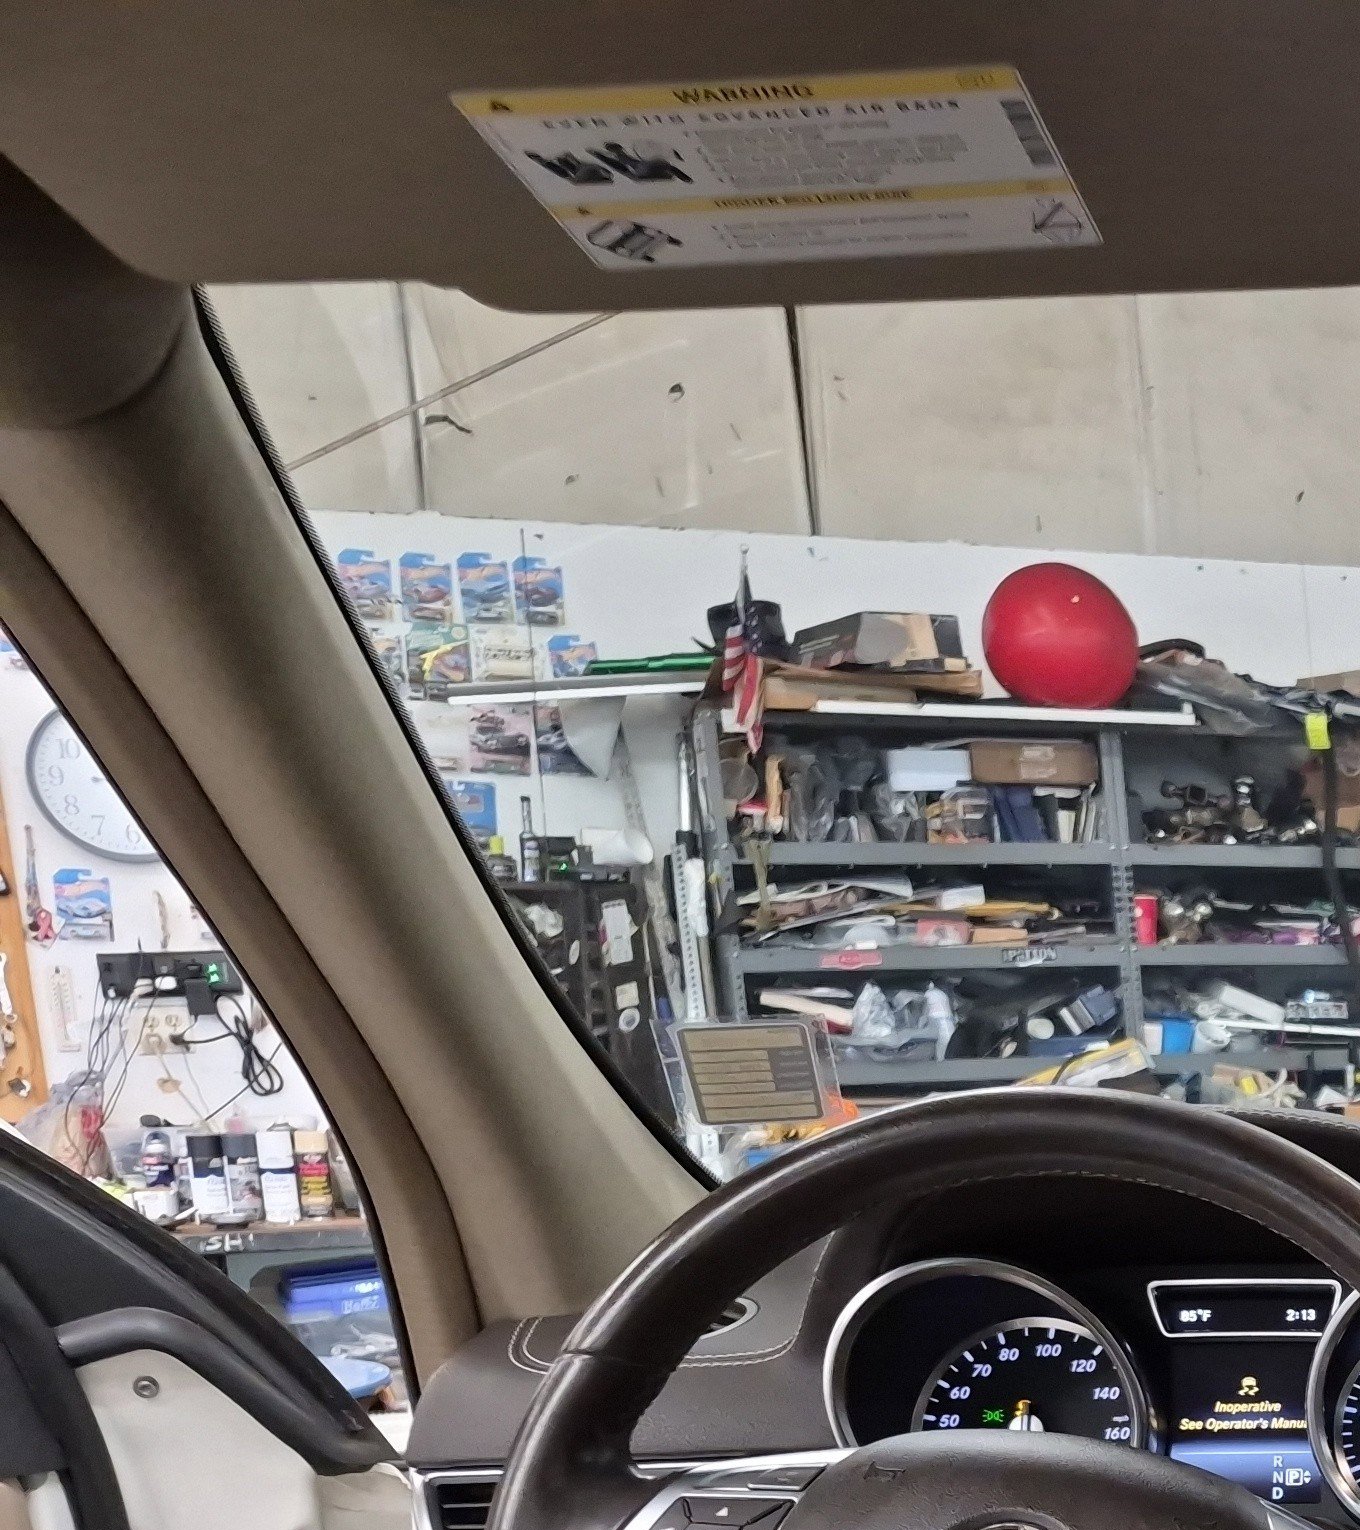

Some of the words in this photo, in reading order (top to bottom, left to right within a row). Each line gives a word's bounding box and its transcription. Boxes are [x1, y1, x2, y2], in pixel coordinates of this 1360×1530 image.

[56, 738, 81, 760] 10
[48, 765, 65, 786] 9
[65, 794, 80, 815] 8
[91, 815, 106, 836] 7
[1286, 1309, 1316, 1322] 2:13
[999, 1348, 1019, 1361] 80
[1036, 1344, 1062, 1357] 100
[972, 1364, 992, 1377] 70
[1070, 1359, 1096, 1372] 120
[950, 1386, 970, 1399] 60
[1093, 1387, 1120, 1400] 140
[1214, 1401, 1281, 1415] Inoperative
[939, 1415, 960, 1428] 50
[1179, 1418, 1203, 1430] See
[1206, 1418, 1269, 1432] Operator's
[1104, 1427, 1131, 1440] 160
[1274, 1455, 1283, 1467] R
[1273, 1472, 1284, 1483] N
[1288, 1471, 1300, 1484] P
[1272, 1487, 1284, 1500] D
